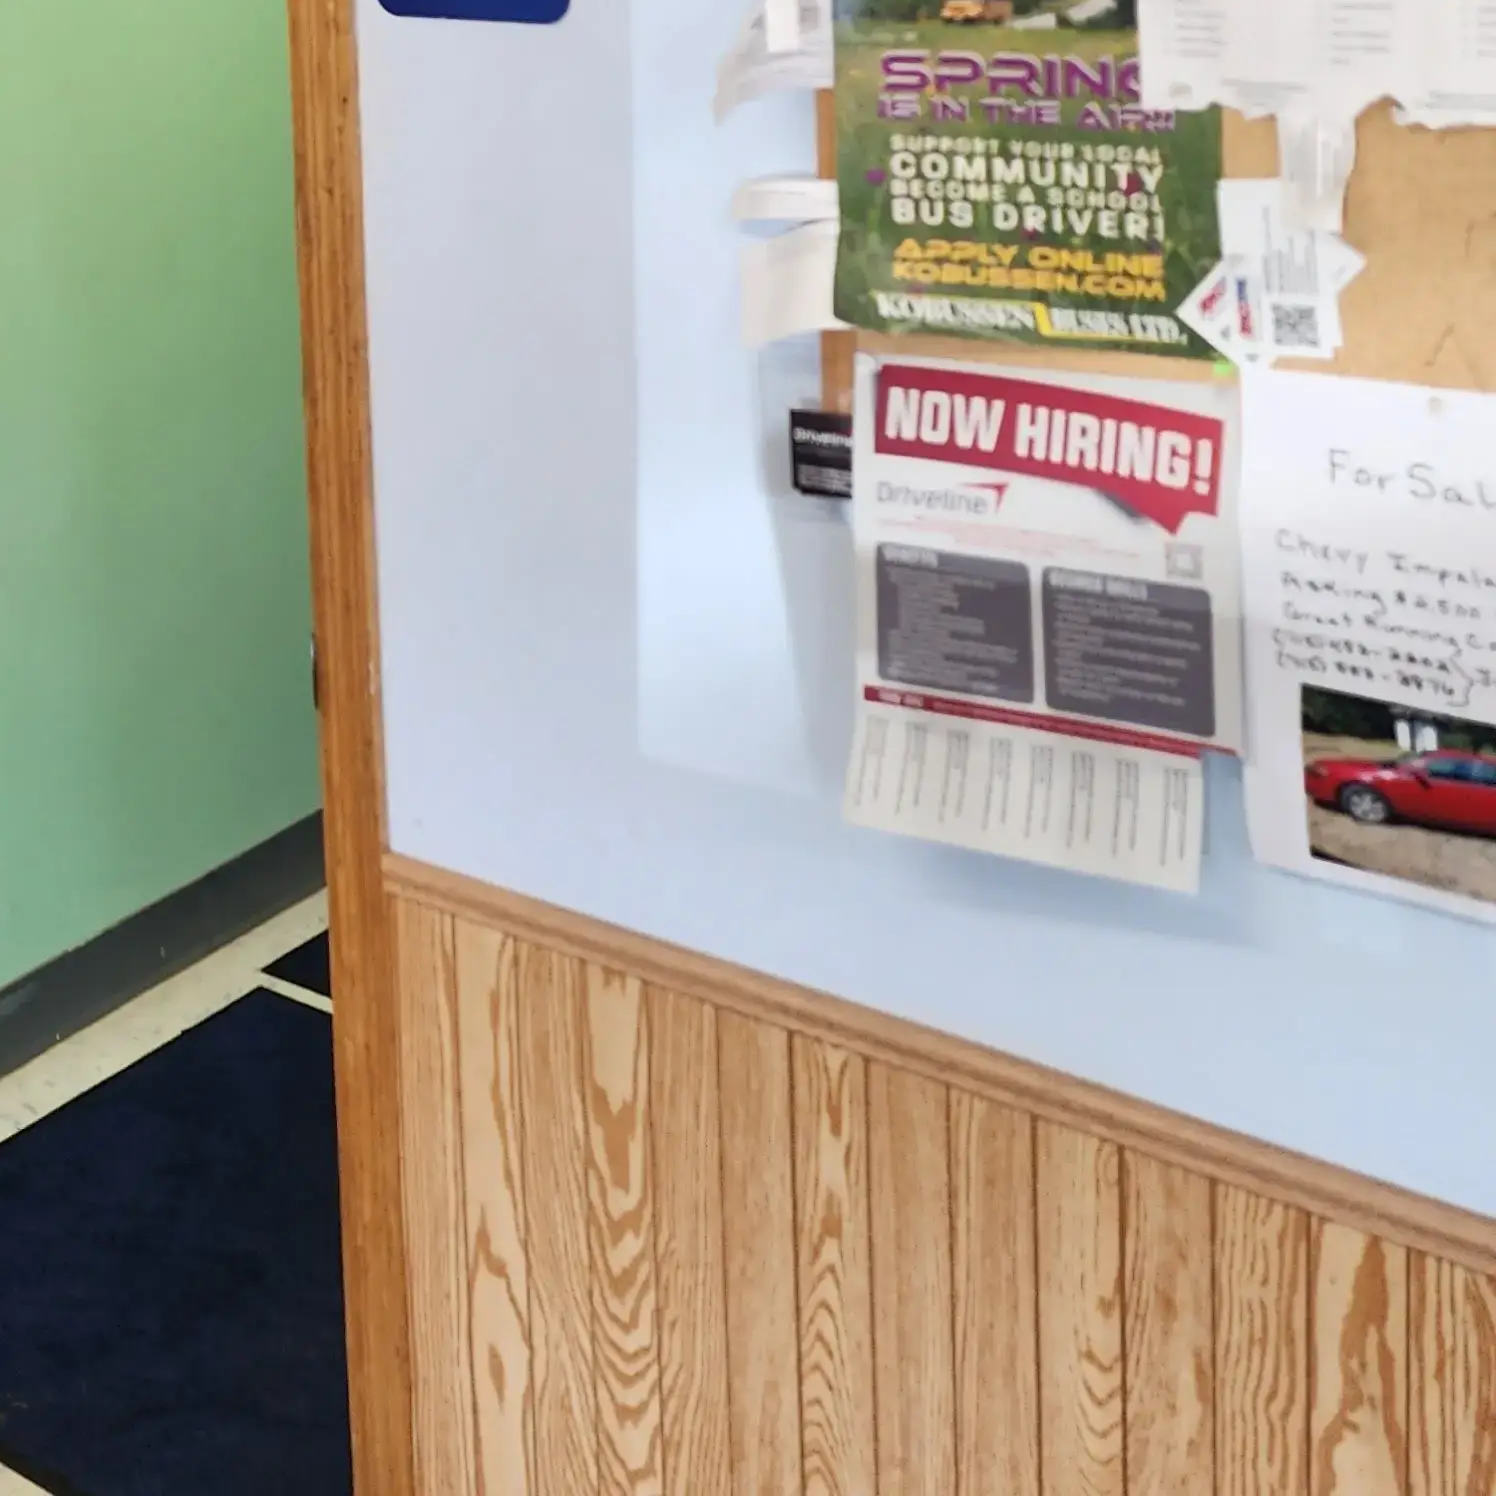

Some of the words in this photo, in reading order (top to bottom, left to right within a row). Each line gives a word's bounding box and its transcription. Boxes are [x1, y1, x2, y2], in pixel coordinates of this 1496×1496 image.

[876, 92, 922, 120] IS
[929, 96, 970, 123] IN
[979, 96, 1062, 126] THE
[889, 133, 1000, 156] SUPPORT
[1007, 140, 1076, 160] YOUR
[1081, 144, 1162, 166] LOCAL
[889, 152, 1165, 195] COMMUNITY
[889, 178, 1009, 203] BECOME
[1016, 185, 1037, 205] A
[1046, 188, 1163, 213] SCHOOL
[890, 197, 975, 227] BUS
[893, 237, 1020, 267] APPLY
[1028, 245, 1165, 278] ONLINE
[892, 260, 1166, 303] KOBUSSEN.COM
[884, 385, 1006, 453] NOW
[1013, 402, 1215, 497] HIRING!
[1328, 447, 1394, 494] For
[875, 480, 990, 516] Driveline
[1274, 528, 1369, 575] Chevy
